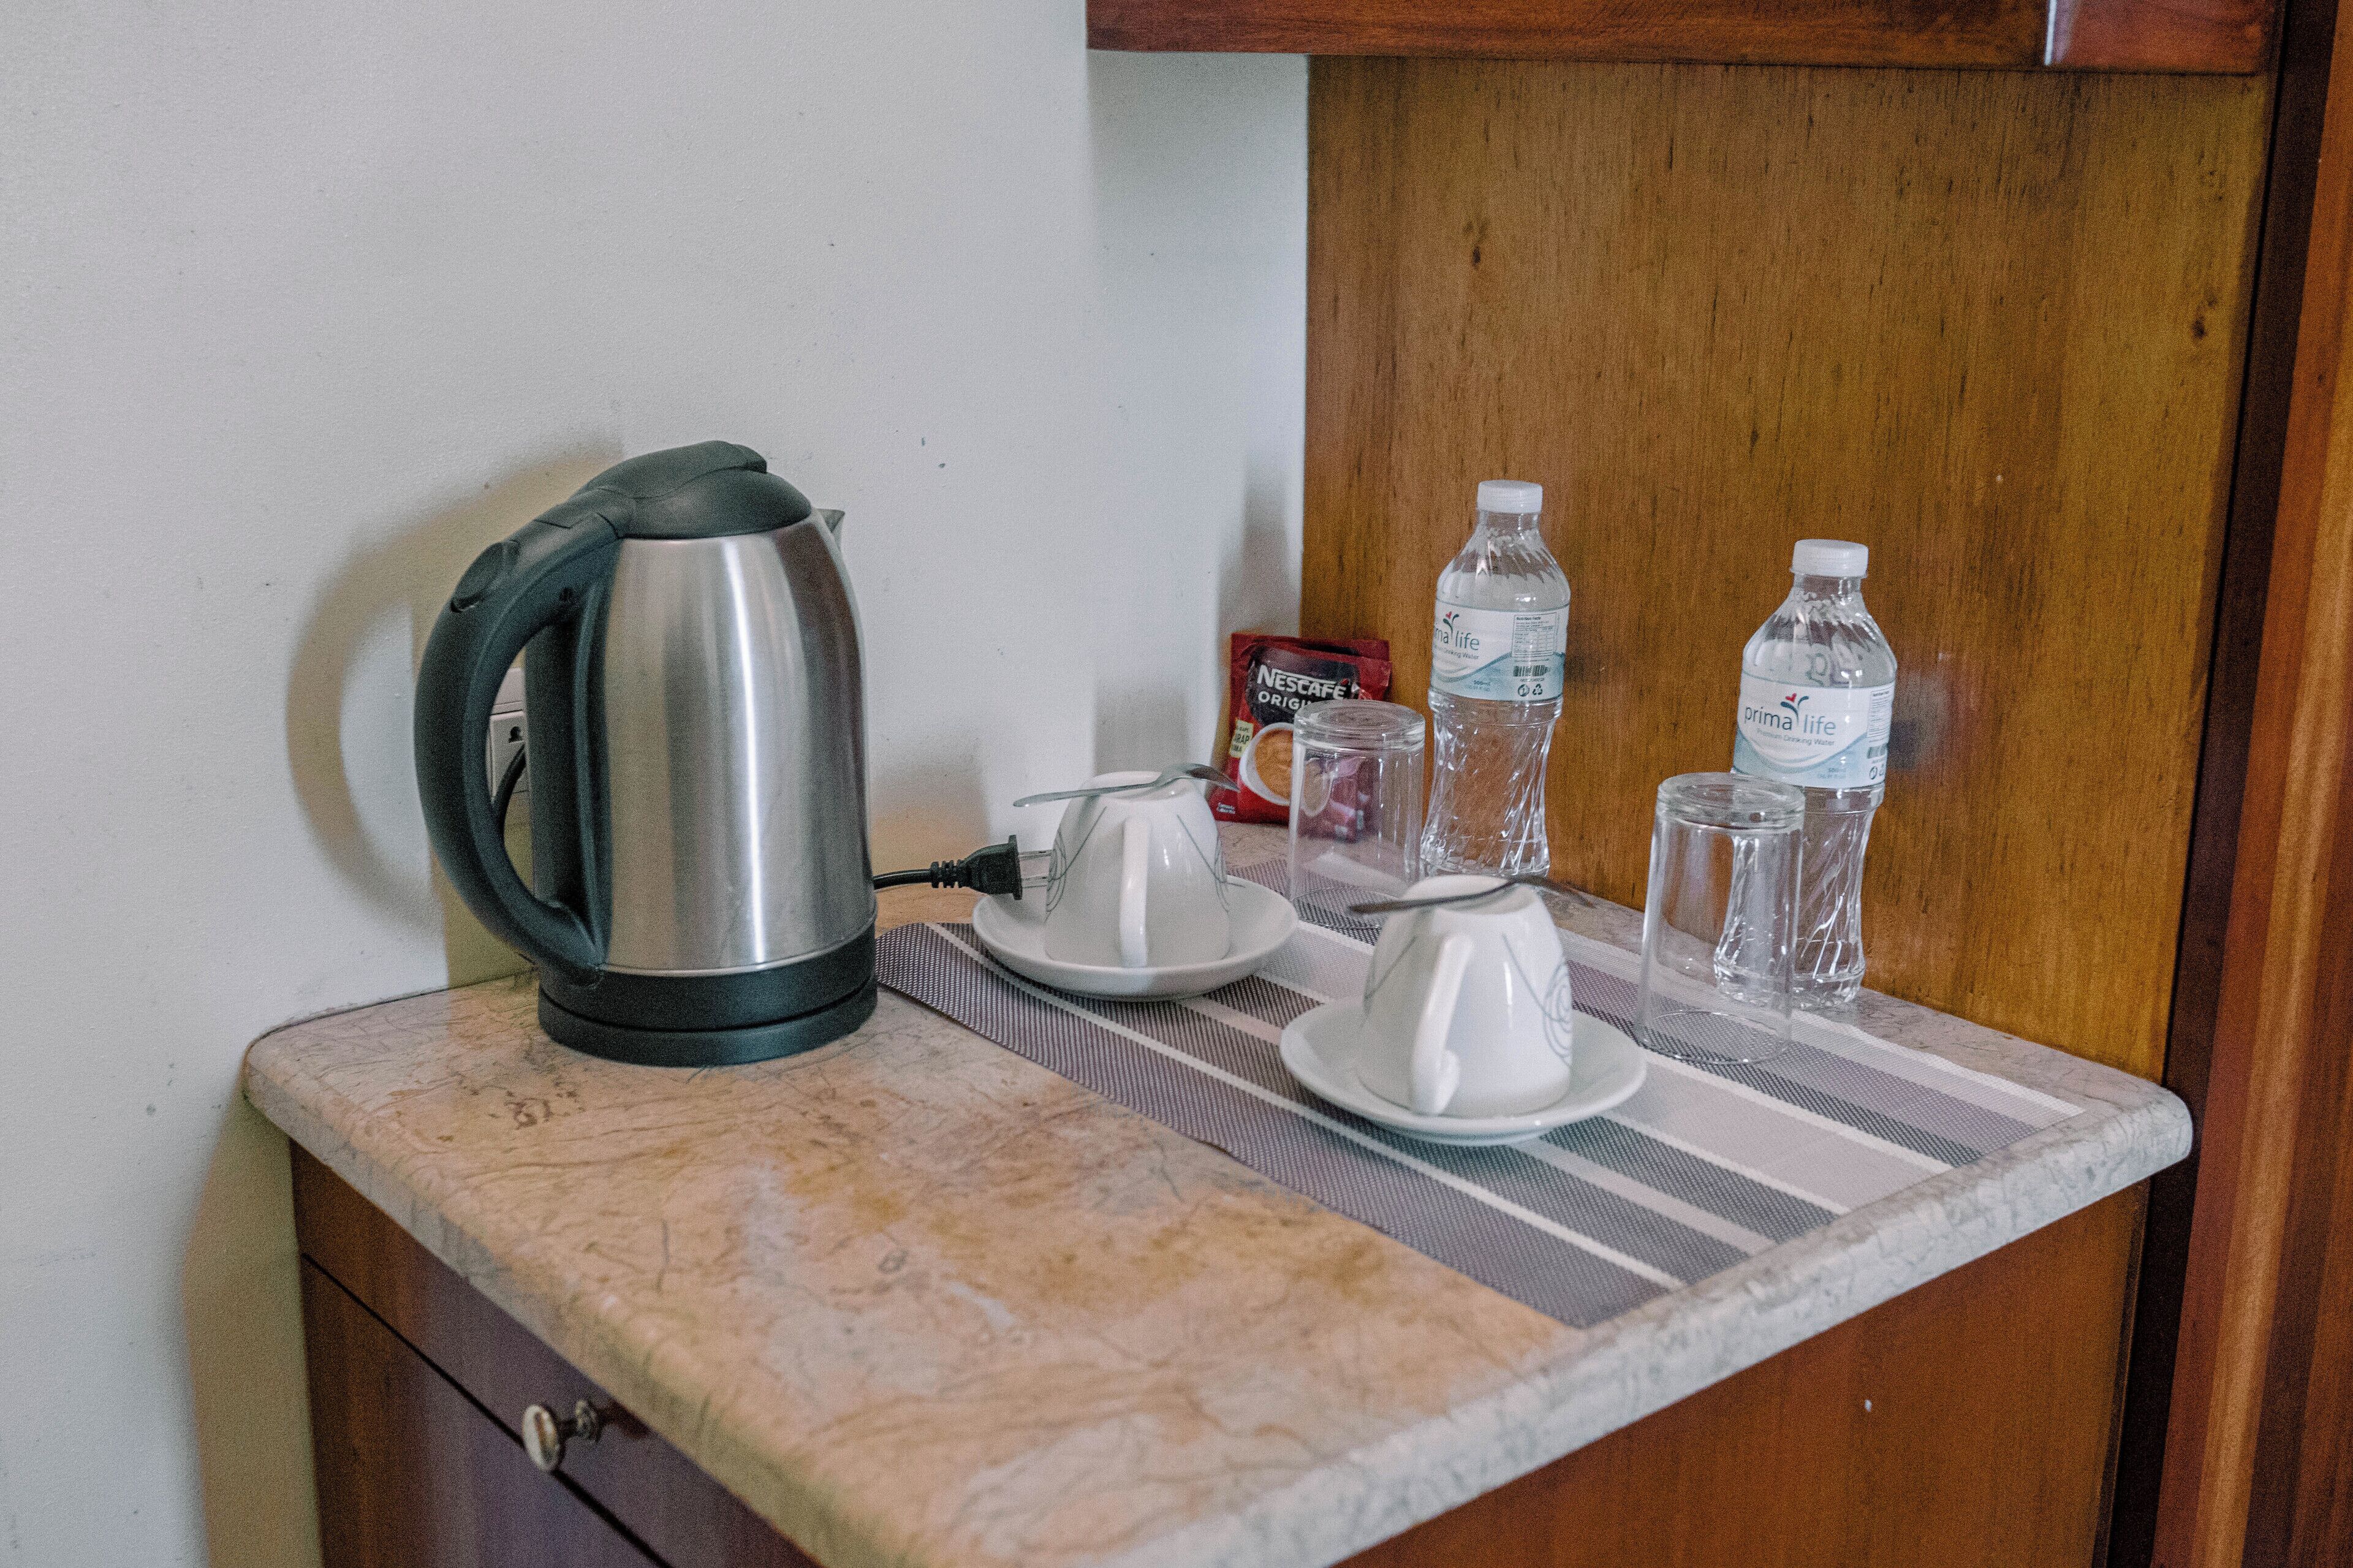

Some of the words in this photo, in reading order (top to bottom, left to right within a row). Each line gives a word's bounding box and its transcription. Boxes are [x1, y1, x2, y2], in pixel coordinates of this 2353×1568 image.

[1455, 631, 1480, 651] life
[1462, 651, 1479, 660] Water
[1257, 665, 1349, 700] NESCAFÉ
[1745, 706, 1792, 730] prima
[1803, 714, 1836, 735] life
[1783, 734, 1811, 746] Drinking
